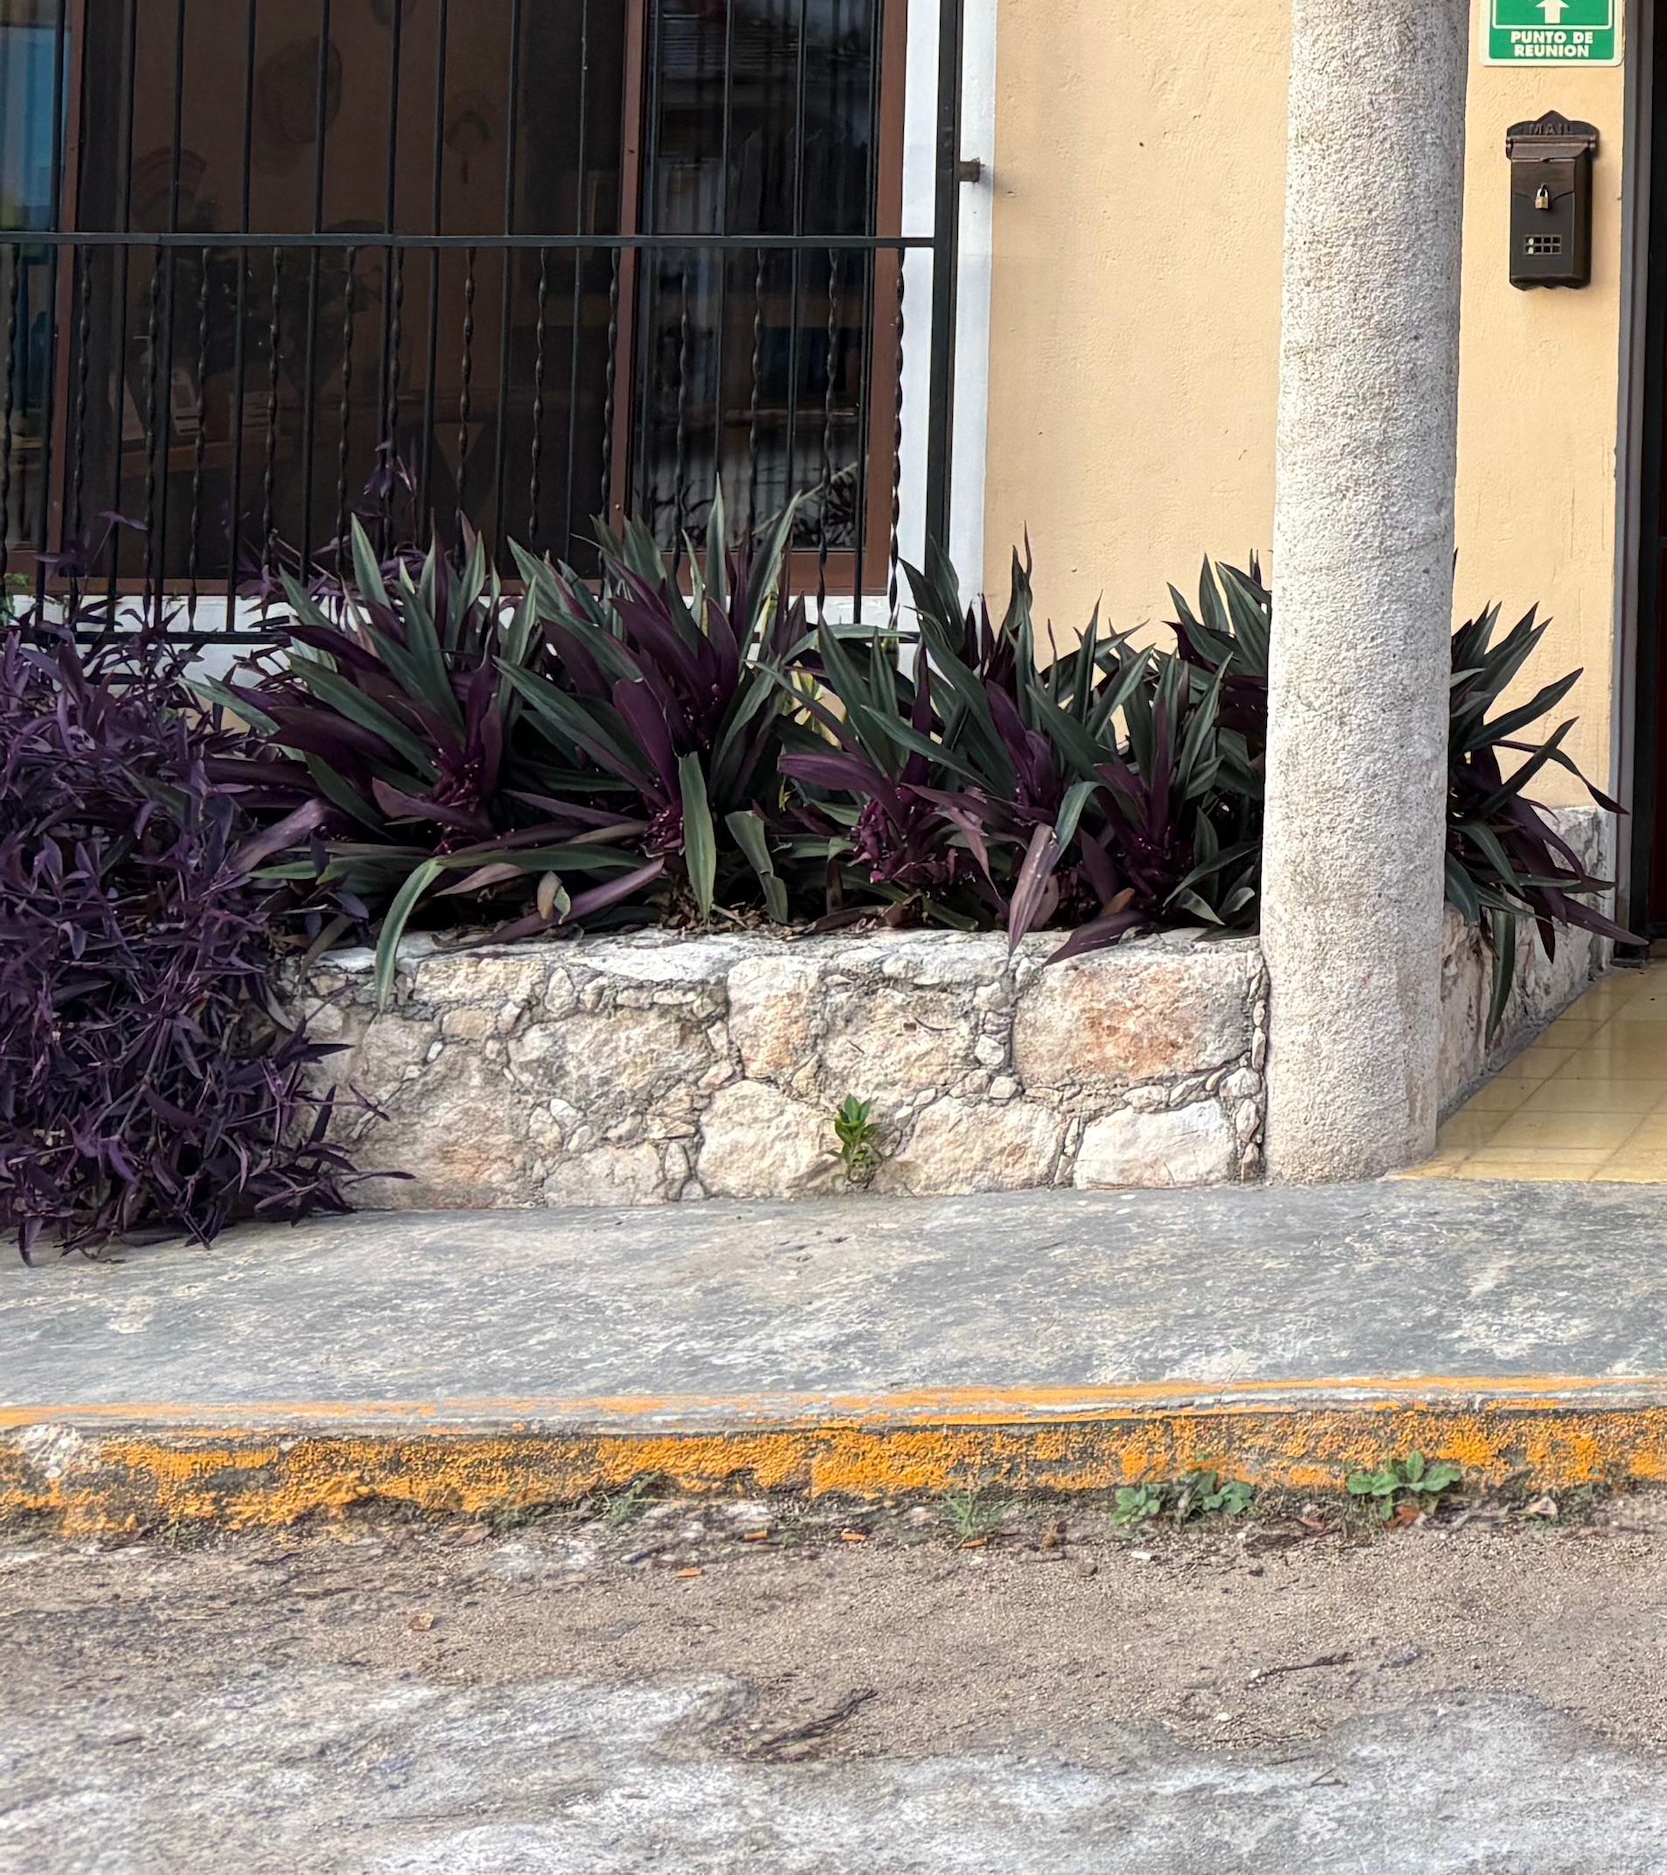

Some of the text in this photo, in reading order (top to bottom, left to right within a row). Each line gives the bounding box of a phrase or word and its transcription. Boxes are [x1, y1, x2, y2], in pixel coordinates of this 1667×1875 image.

[1511, 31, 1593, 44] PUNTO DE
[1514, 44, 1589, 57] REUNION
[1529, 123, 1573, 135] MAIL
